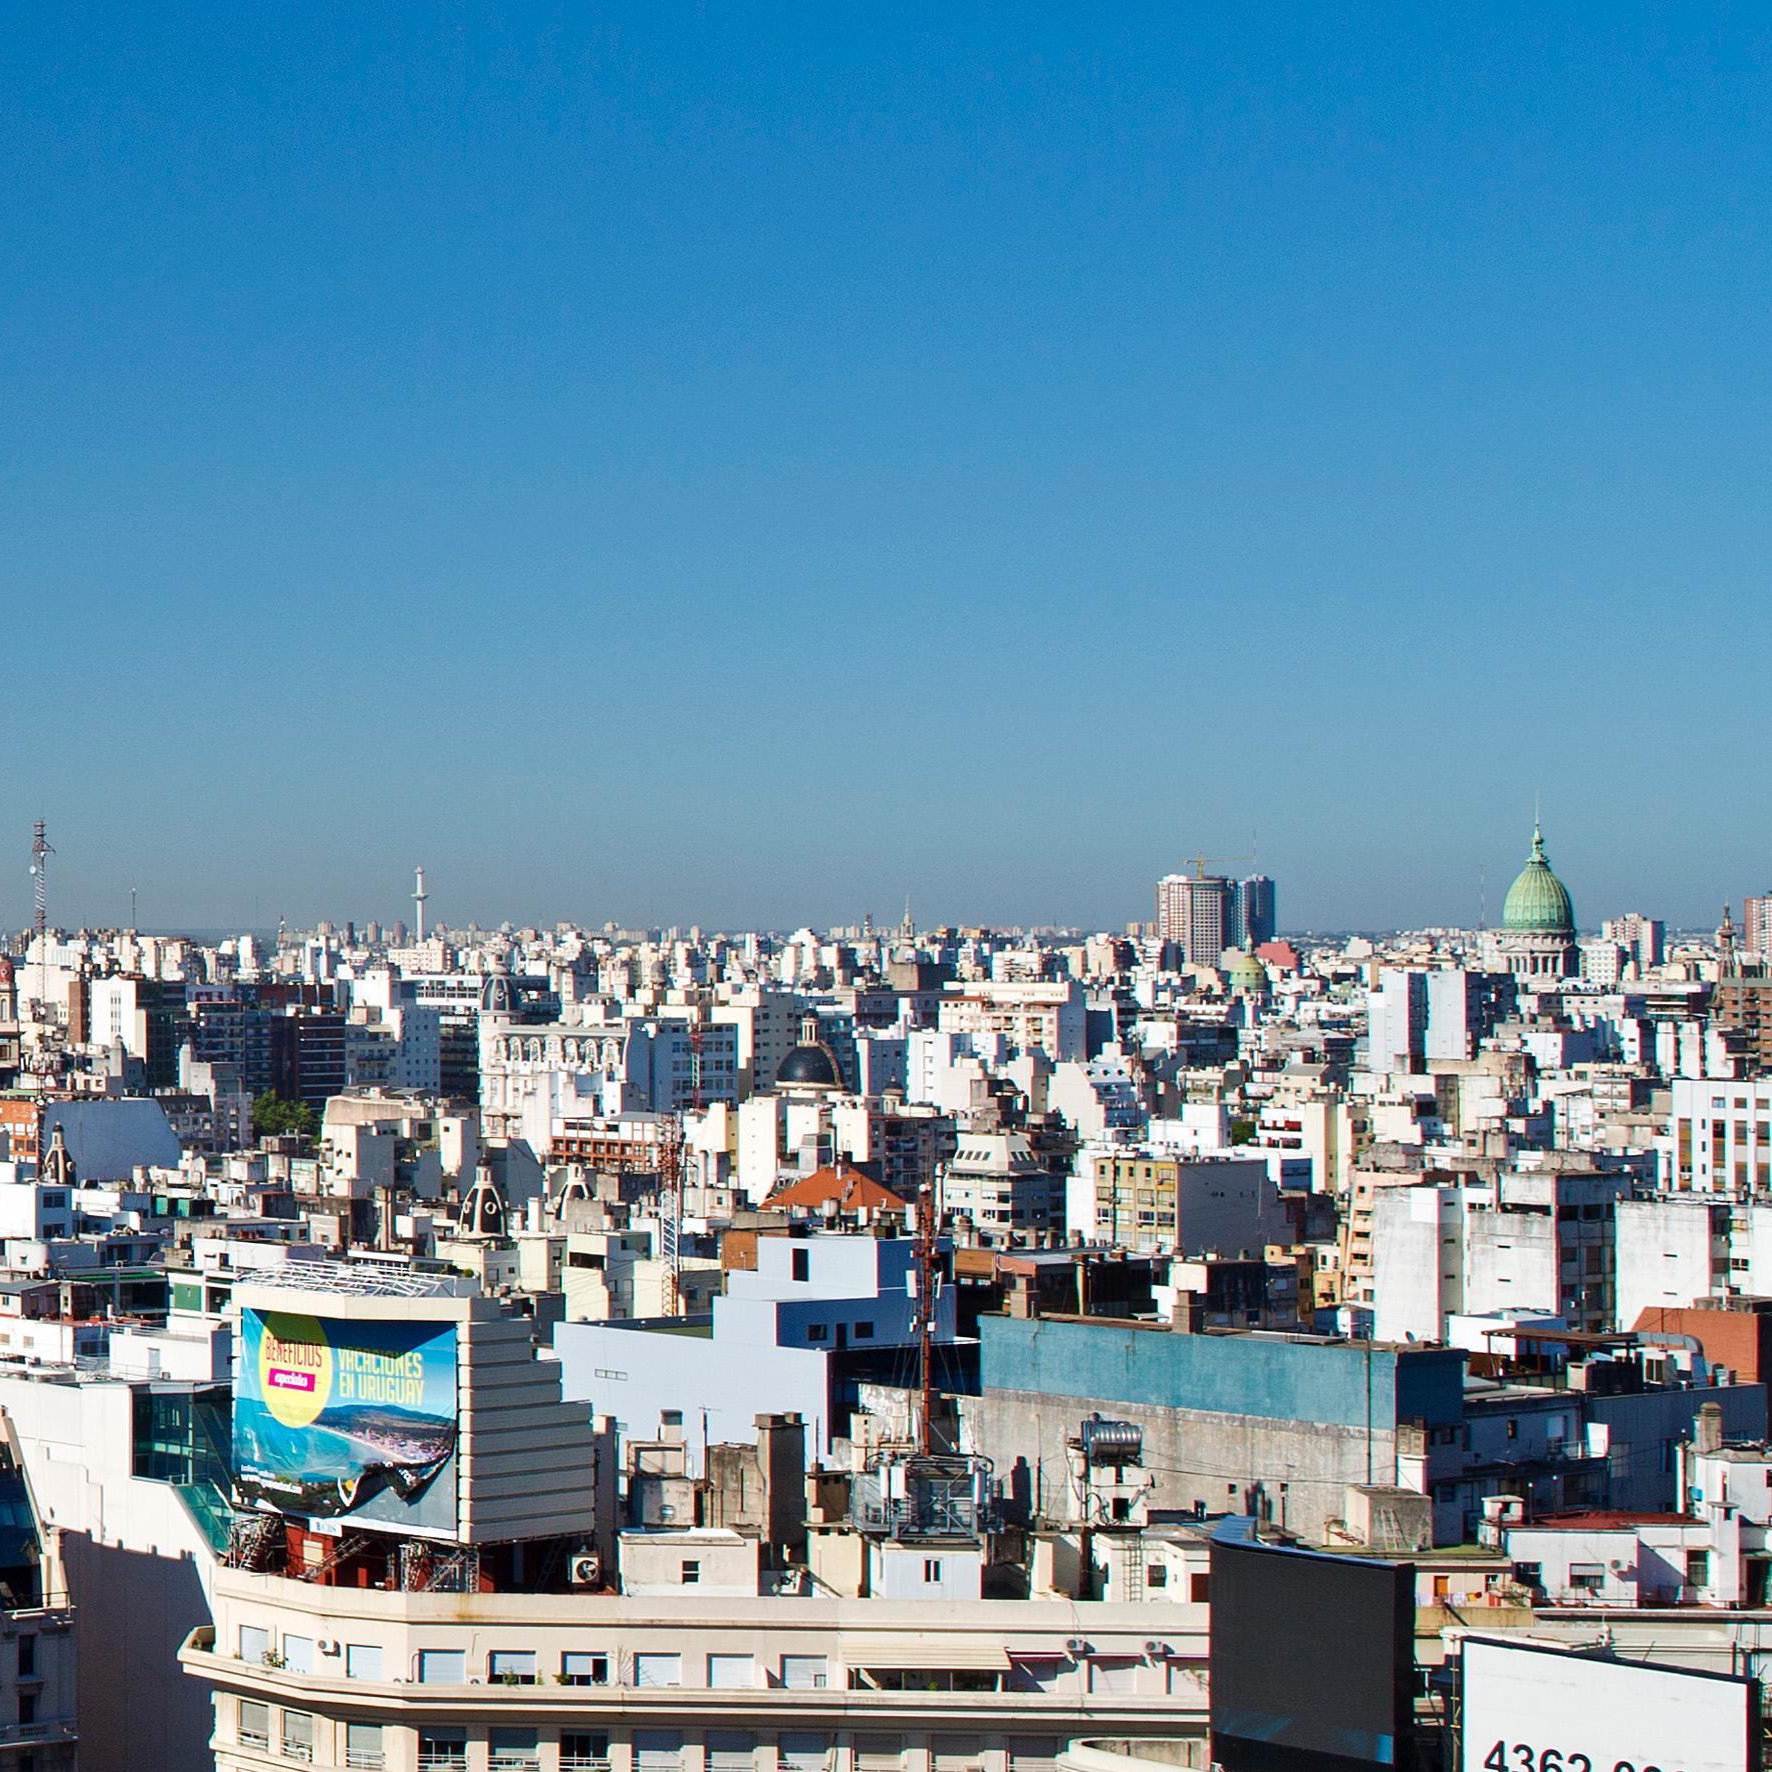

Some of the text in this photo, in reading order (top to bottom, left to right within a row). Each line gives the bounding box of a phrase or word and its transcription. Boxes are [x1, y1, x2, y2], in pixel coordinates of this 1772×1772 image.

[265, 1336, 323, 1368] BENEFICIOS
[337, 1346, 423, 1379] VACACIONES
[339, 1373, 425, 1407] EN URUGUAY
